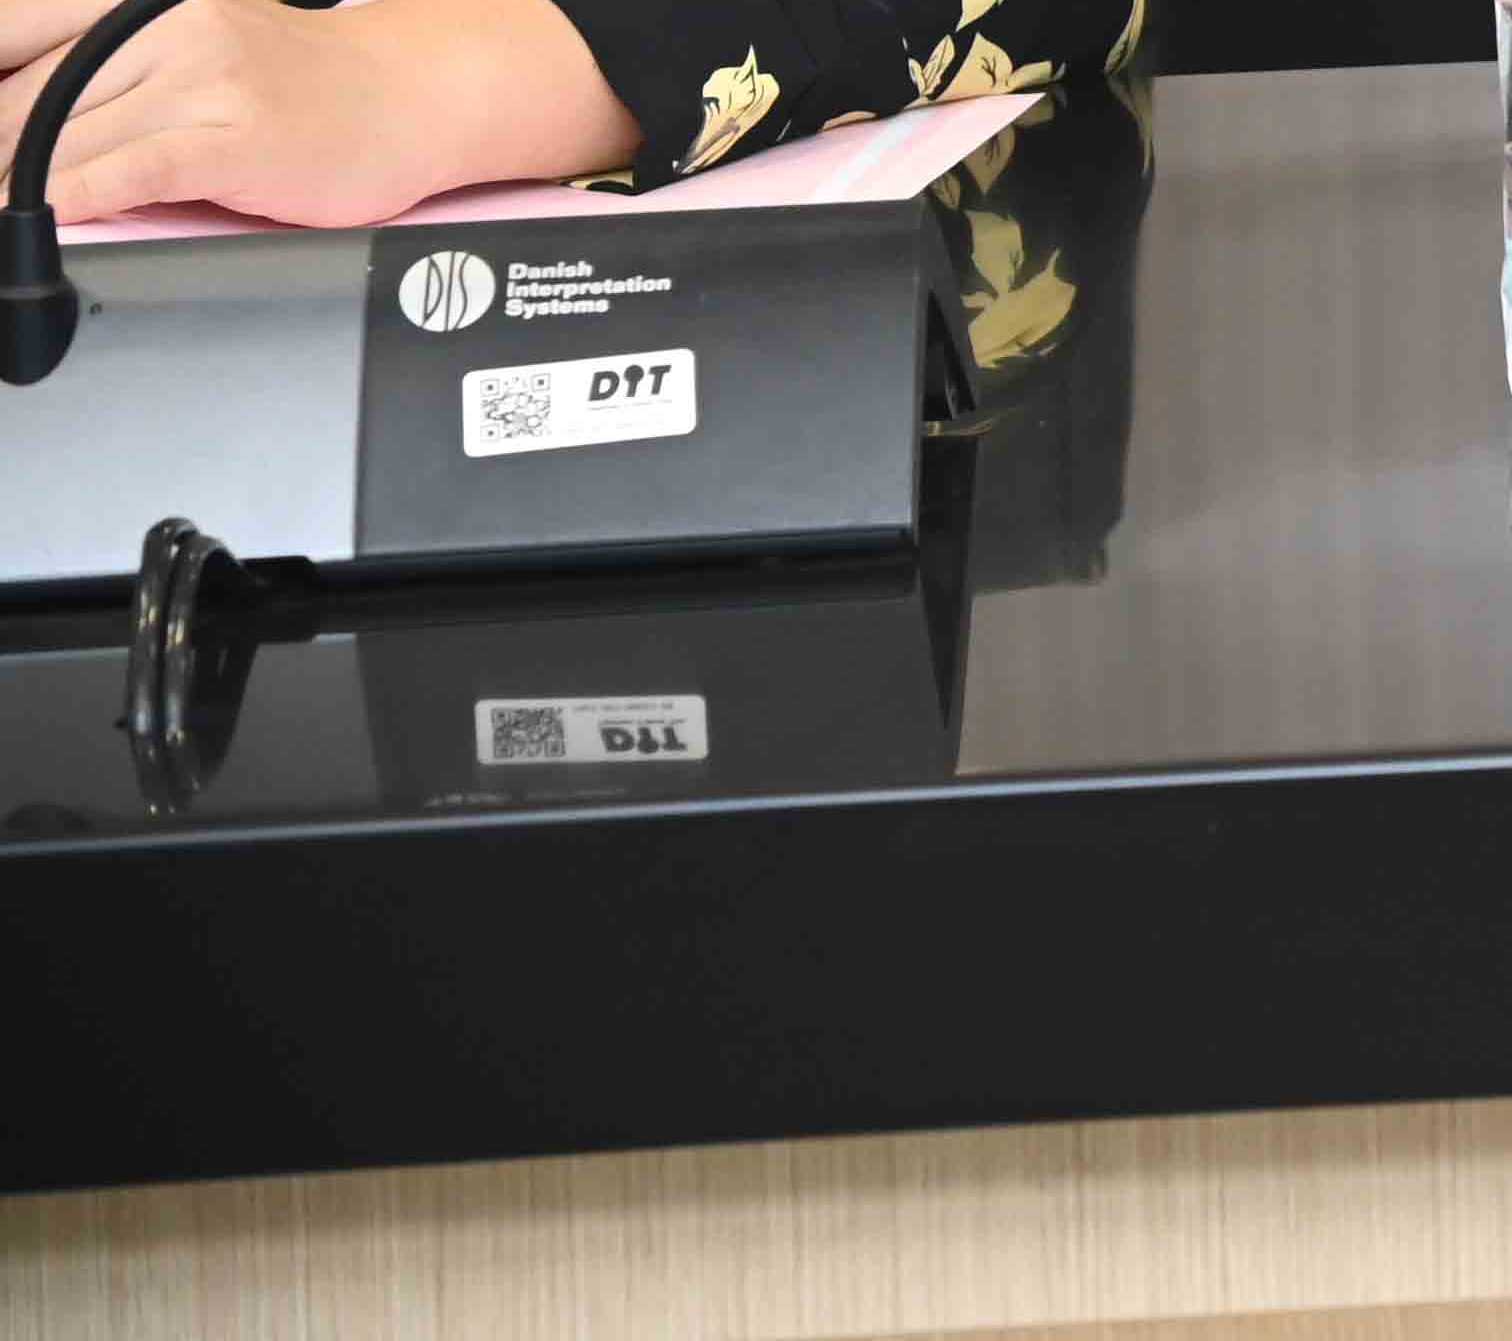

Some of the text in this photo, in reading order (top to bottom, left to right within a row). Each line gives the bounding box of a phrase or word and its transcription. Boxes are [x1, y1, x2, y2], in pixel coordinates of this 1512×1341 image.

[507, 260, 593, 280] Danish
[506, 275, 672, 299] Interpretation
[504, 297, 609, 319] Systems
